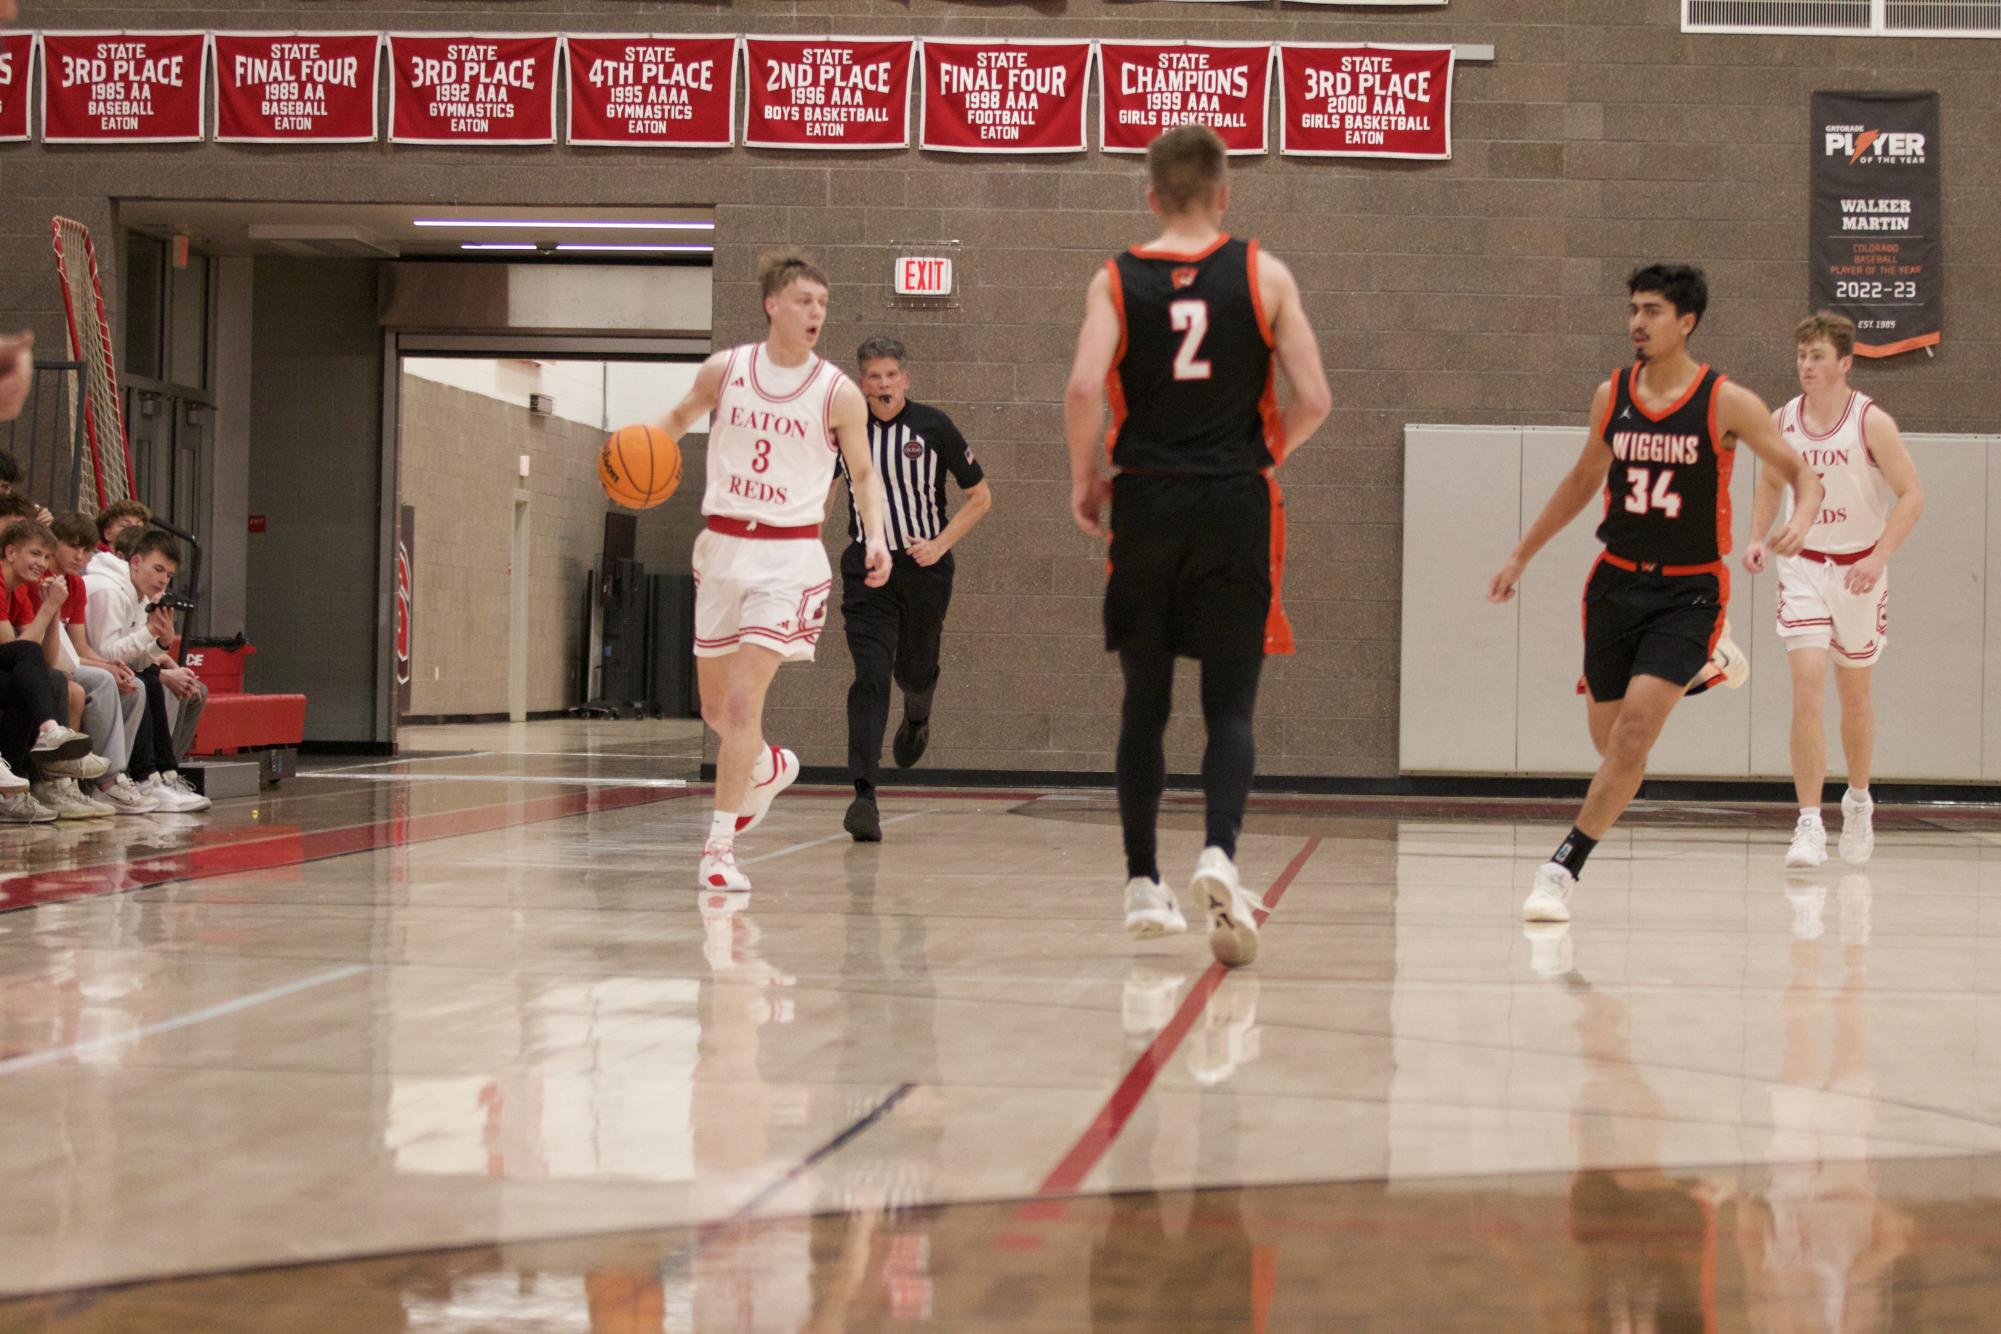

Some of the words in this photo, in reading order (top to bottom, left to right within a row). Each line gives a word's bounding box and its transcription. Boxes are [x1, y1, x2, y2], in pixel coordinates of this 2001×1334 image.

[97, 43, 147, 60] STATE
[270, 43, 321, 60] STATE
[447, 44, 498, 61] STATE
[624, 46, 676, 63] STATE
[802, 48, 853, 66] STATE
[976, 51, 1028, 69] STATE
[1158, 52, 1210, 70] STATE
[1340, 56, 1393, 73] STATE
[61, 55, 107, 88] 3RD
[113, 55, 184, 87] PLACE
[235, 54, 296, 88] FINAL
[301, 56, 358, 89] FOUR
[411, 55, 457, 88] 3RD
[463, 56, 536, 91] PLACE
[588, 58, 634, 88] 4TH
[641, 59, 714, 92] PLACE
[766, 58, 813, 91] 2ND
[815, 61, 891, 92] PLACE
[940, 62, 1003, 96] FINAL
[1007, 65, 1067, 98] FOUR
[1121, 61, 1249, 99] CHAMPIONS
[91, 81, 125, 100] 1985
[130, 82, 151, 100] AA
[265, 81, 299, 101] 1989
[303, 82, 325, 101] AA
[435, 83, 470, 102] 1992
[475, 83, 508, 103] AAA
[1304, 67, 1352, 101] 3RD
[1358, 70, 1431, 103] PLACE
[610, 85, 643, 104] 1995
[647, 85, 689, 105] AAAA
[790, 86, 826, 105] 1996
[830, 86, 864, 106] AAA
[964, 90, 1003, 109] 1998
[1005, 90, 1039, 110] AAA
[1146, 91, 1182, 111] 1999
[1186, 91, 1220, 112] AAA
[88, 100, 155, 116] BASEBALL
[261, 100, 328, 116] BASEBALL
[429, 102, 515, 118] GYMNASTICS
[606, 103, 693, 120] GYMNASTICS
[764, 104, 800, 121] BOYS
[803, 106, 889, 123] BASKETBALL
[1327, 94, 1368, 114] 2000
[1372, 95, 1406, 116] AAA
[101, 116, 139, 130] EATON
[274, 116, 312, 131] EATON
[450, 118, 489, 133] EATON
[628, 119, 667, 134] EATON
[967, 109, 1036, 126] FOOTBALL
[1118, 109, 1157, 126] GIRLS
[1161, 110, 1247, 128] BASKETBALL
[1301, 113, 1341, 129] GIRLS
[1344, 114, 1431, 131] BASKETBALL
[805, 122, 845, 137] EATON
[980, 125, 1020, 140] EATON
[1345, 129, 1384, 145] EATON
[1825, 124, 1864, 132] GATORADE
[1859, 156, 1873, 164] OF
[1877, 156, 1896, 164] THE
[1899, 156, 1926, 164] YEAR
[1840, 199, 1912, 214] WALKER
[1842, 216, 1910, 231] MARTIN
[1852, 243, 1900, 253] COLORADO
[1853, 255, 1898, 264] BASEBALL
[904, 260, 945, 291] EXIT
[1830, 266, 1863, 275] PLAYER
[1864, 265, 1877, 275] OF
[1880, 265, 1897, 275] THE
[1898, 265, 1922, 274] YEAR
[1836, 281, 1917, 298] 2022-23
[1169, 297, 1213, 381] 2
[730, 405, 809, 441] EATON
[751, 439, 771, 474] 3
[1612, 431, 1700, 465] WIGGINS
[1801, 448, 1850, 467] ATON
[728, 474, 789, 507] REDS
[1624, 467, 1683, 519] 34
